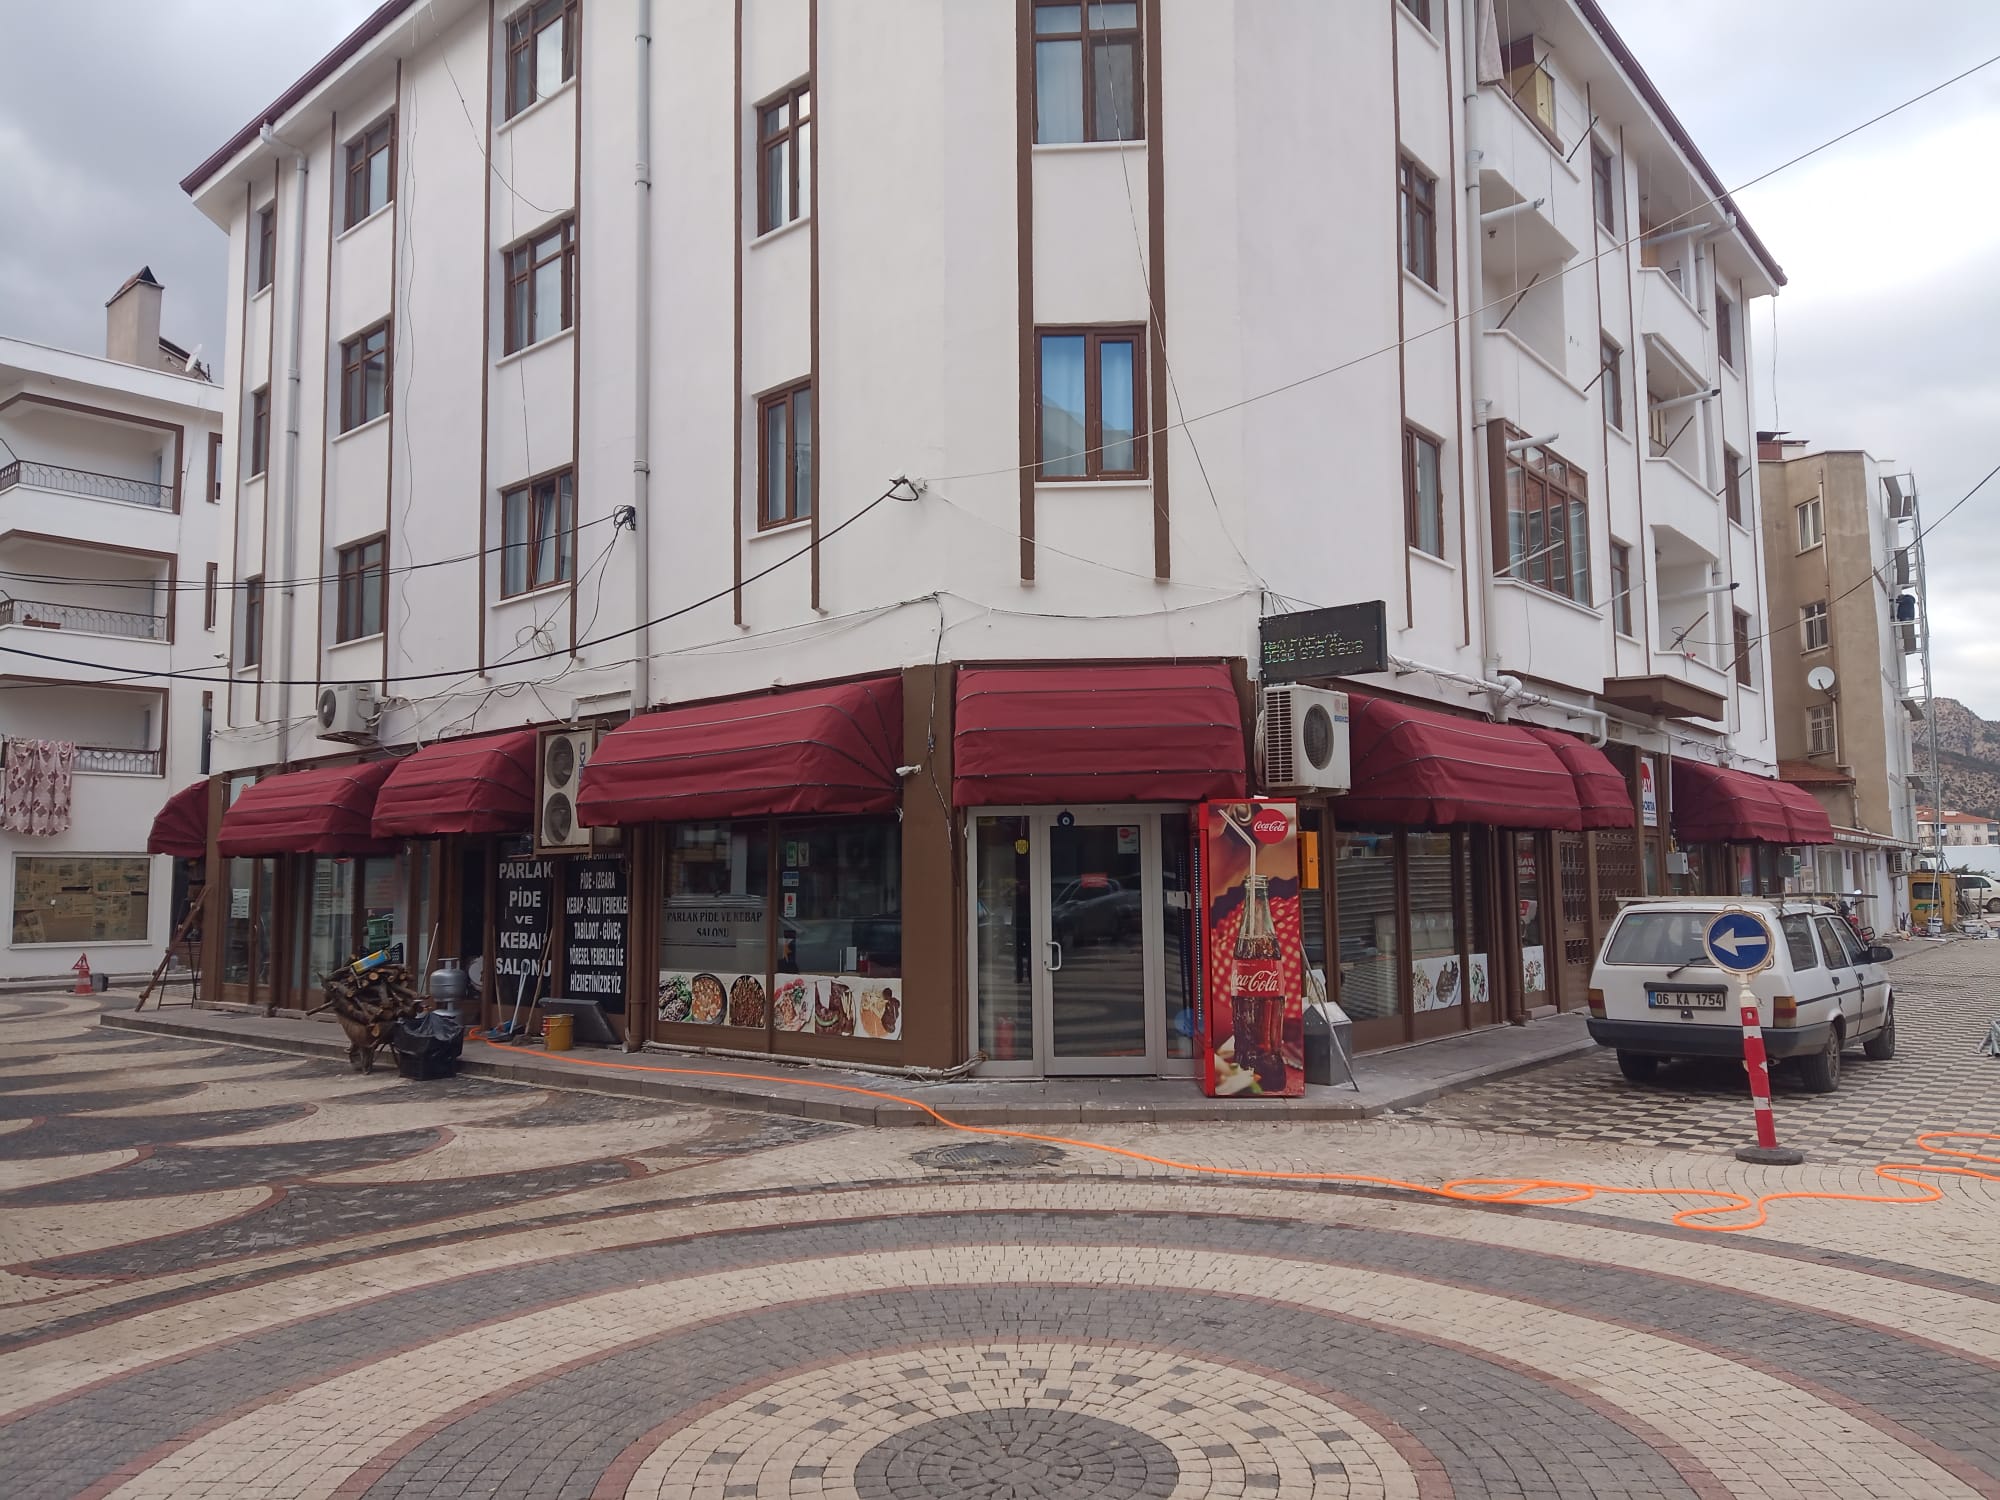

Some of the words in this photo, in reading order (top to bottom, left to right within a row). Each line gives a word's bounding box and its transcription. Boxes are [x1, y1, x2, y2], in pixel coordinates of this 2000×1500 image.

[499, 861, 554, 879] PARLAK
[580, 868, 592, 890] PİDE
[595, 871, 616, 889] IZGARA
[509, 886, 541, 908] PİDE
[566, 896, 584, 914] KEBAP
[587, 896, 601, 914] SULU
[514, 915, 534, 925] VE
[667, 911, 698, 923] PARLAK
[720, 911, 731, 922] VE
[733, 911, 763, 923] KEBAP
[602, 919, 621, 944] GÜVEÇ
[569, 944, 590, 965] YÖRESEL
[590, 947, 615, 966] YEMEKLER
[496, 958, 552, 977] SALONU
[1233, 970, 1280, 992] ca-Cola
[1656, 993, 1669, 1005] 06
[1676, 993, 1690, 1006] KA
[1695, 993, 1722, 1006] 1754
